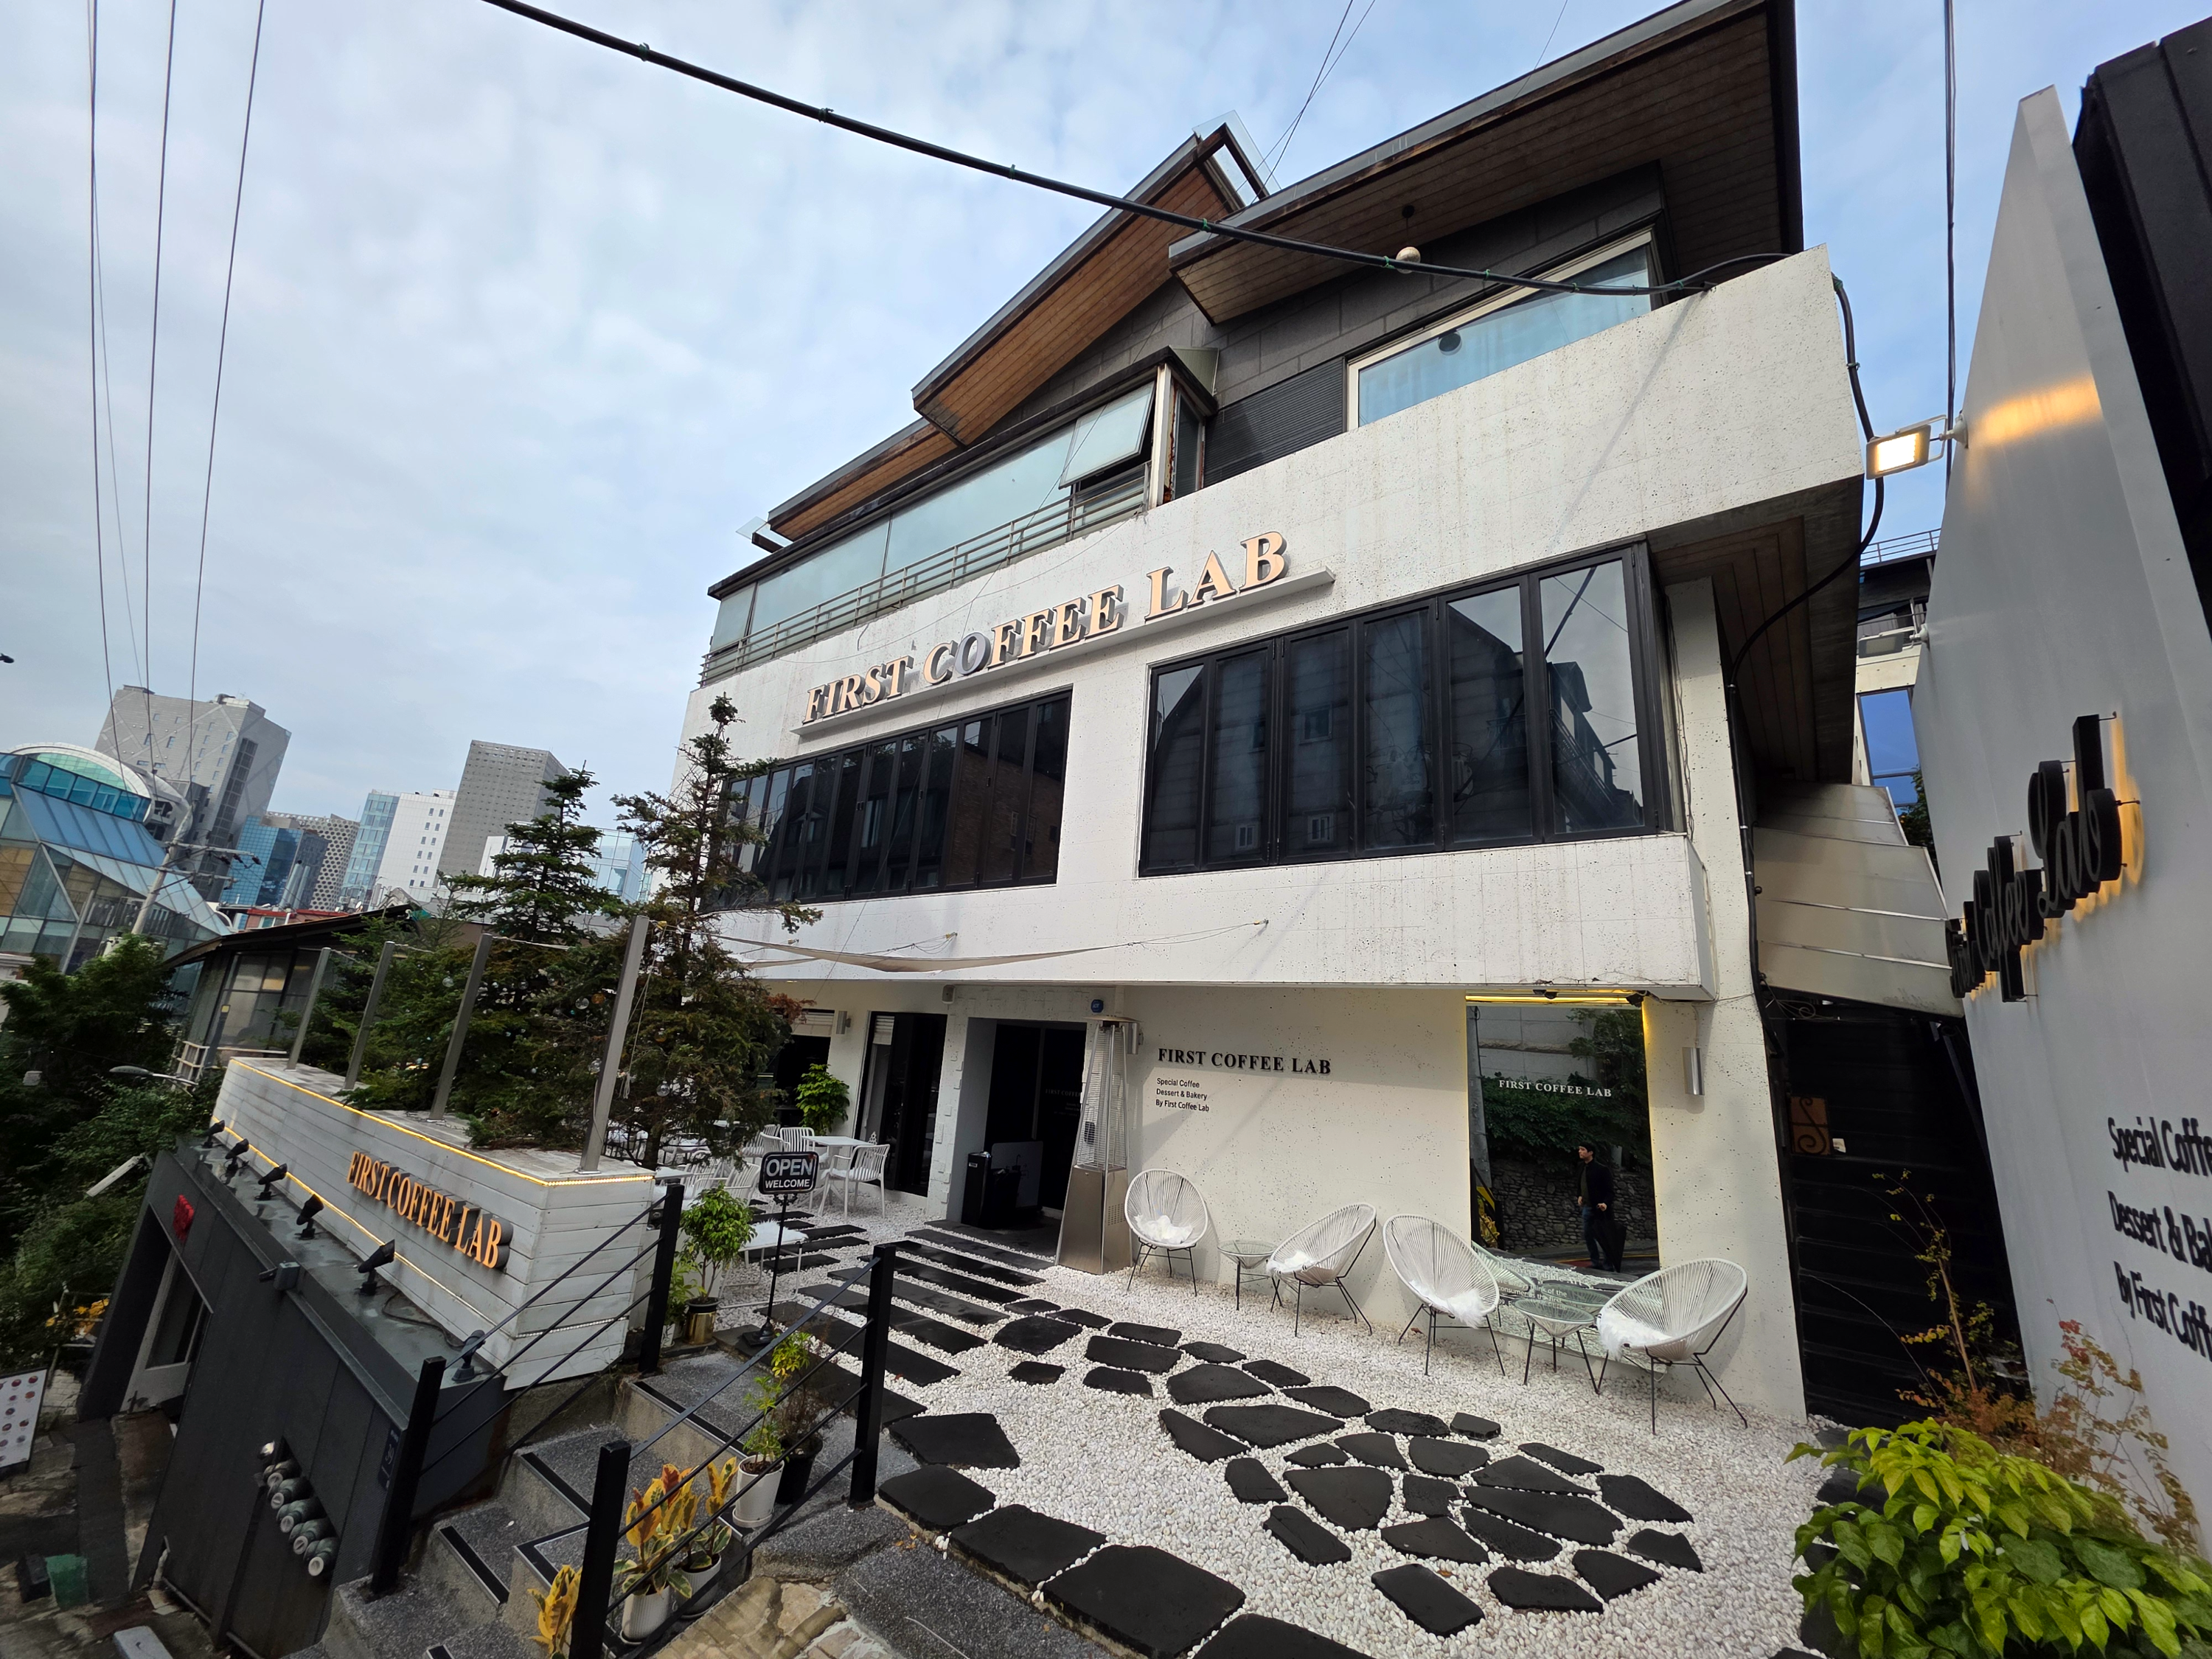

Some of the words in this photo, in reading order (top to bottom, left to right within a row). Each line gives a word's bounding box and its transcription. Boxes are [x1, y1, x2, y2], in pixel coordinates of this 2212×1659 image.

[802, 655, 914, 724] FIRST
[923, 584, 1125, 686] COFFEE
[1144, 530, 1289, 622] LAB
[1158, 1047, 1206, 1066] FIRST
[1211, 1052, 1284, 1072] COFFEE
[1291, 1057, 1331, 1074] LAB
[1157, 1077, 1178, 1087] Special
[1180, 1079, 1200, 1088] Coffee
[1498, 1079, 1531, 1091] FIRST
[1535, 1082, 1583, 1095] COFFEE
[1586, 1085, 1613, 1097] LAB
[1156, 1088, 1179, 1097] Dessert
[1186, 1091, 1208, 1101] Bakery
[1155, 1099, 1163, 1107] By
[1164, 1099, 1178, 1108] First
[1178, 1102, 1197, 1110] Coffee
[1199, 1104, 1209, 1112] Lab
[2107, 1116, 2166, 1173] Special
[766, 1158, 813, 1178] OPEN
[765, 1178, 810, 1189] WELCOME
[347, 1151, 392, 1201] FIRST
[387, 1171, 459, 1243] COFFEE
[454, 1205, 511, 1269] LAB
[2107, 1190, 2168, 1253] Dessert
[2164, 1206, 2188, 1264] &
[1556, 1290, 1568, 1298] the
[2114, 1261, 2136, 1320] By
[2129, 1270, 2172, 1335] First
